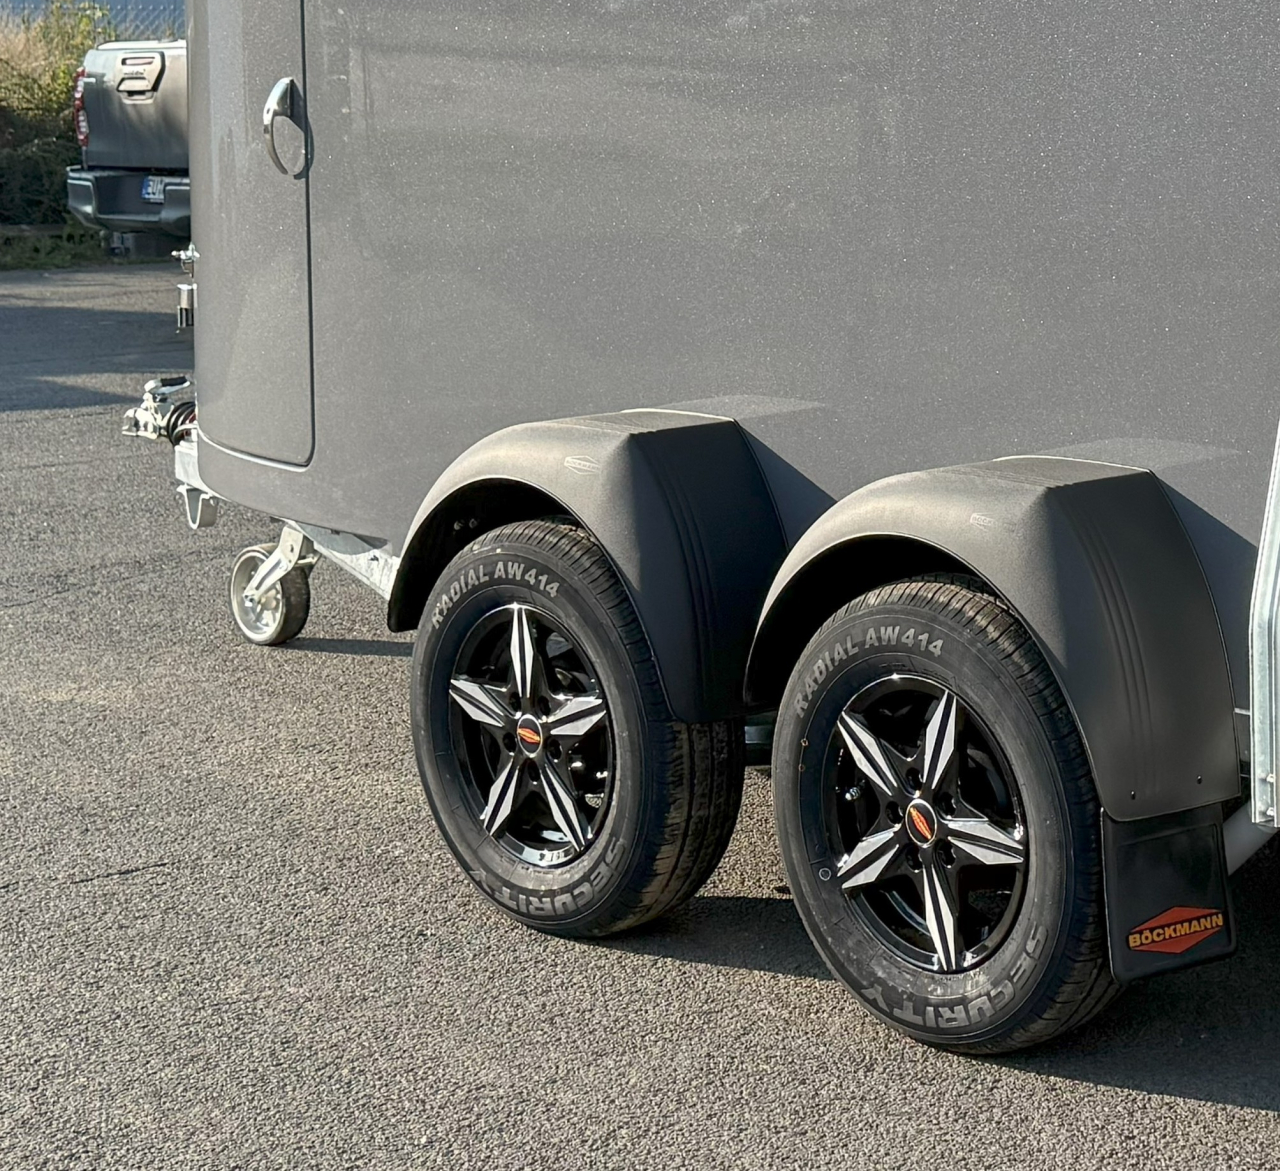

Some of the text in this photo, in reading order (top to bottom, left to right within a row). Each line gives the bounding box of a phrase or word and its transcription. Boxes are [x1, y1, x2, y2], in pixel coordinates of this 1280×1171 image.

[431, 561, 560, 630] RADIAL AW414
[793, 626, 944, 718] RADIAL AW414
[468, 836, 627, 916] SECURITY
[1128, 913, 1224, 948] BÖCKMANN
[860, 922, 1049, 1028] SECURITY
